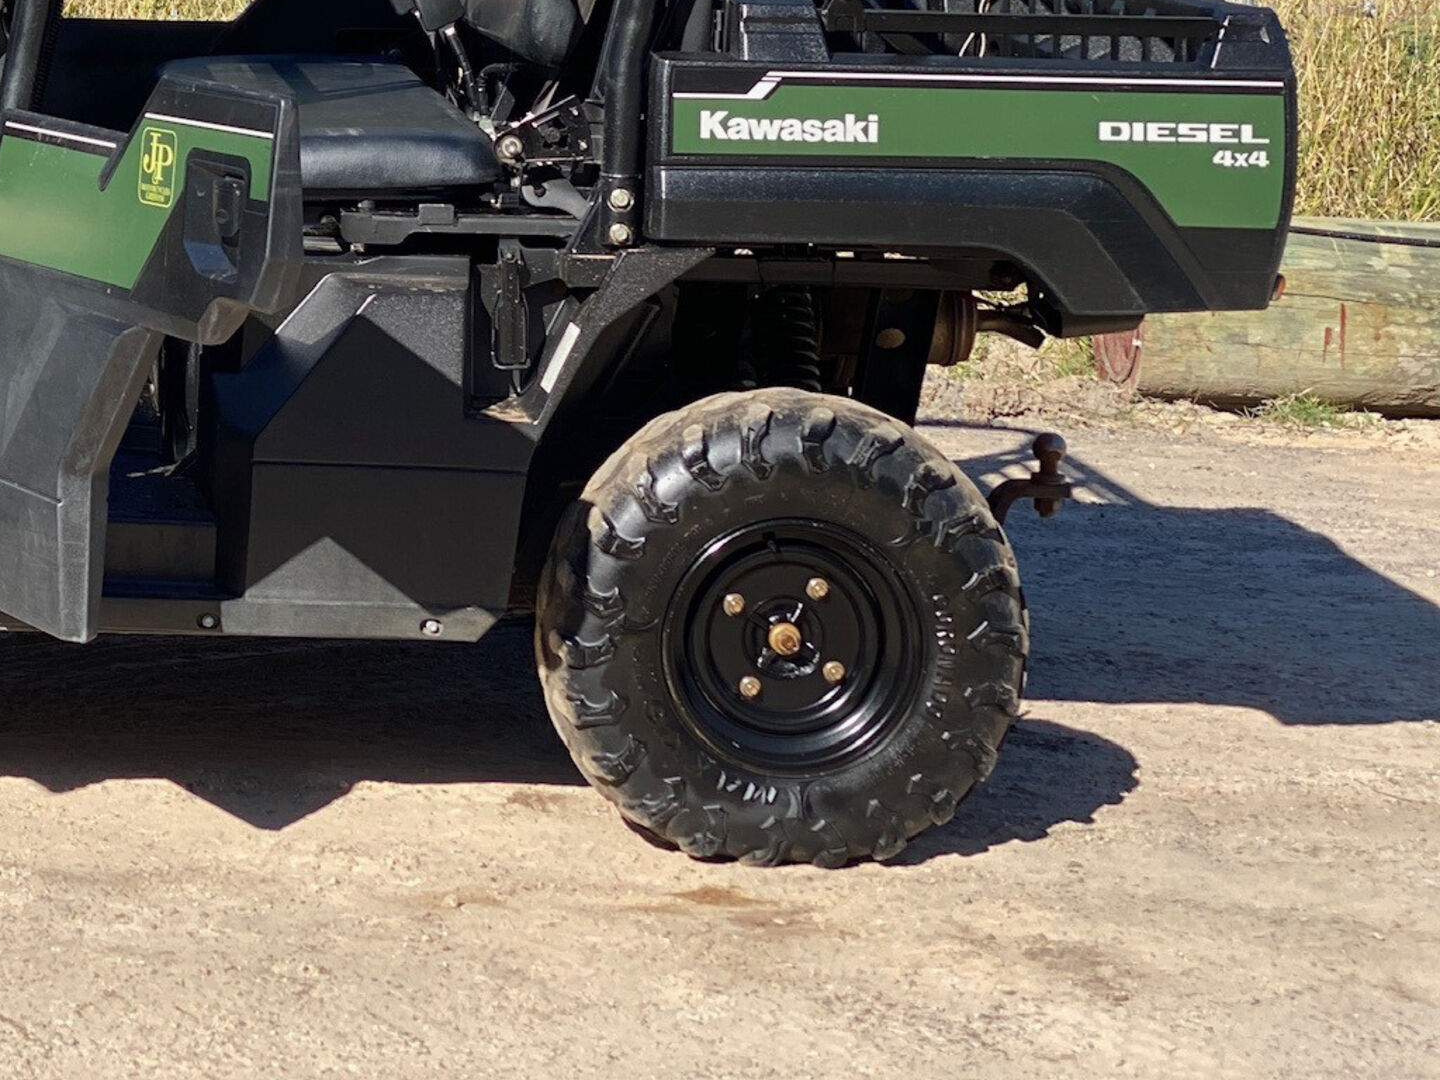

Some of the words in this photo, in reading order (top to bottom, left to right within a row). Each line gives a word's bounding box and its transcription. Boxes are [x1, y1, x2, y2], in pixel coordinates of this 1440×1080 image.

[699, 110, 879, 144] Kawasaki
[1098, 120, 1270, 144] DIESEL
[1212, 149, 1270, 168] 4x4
